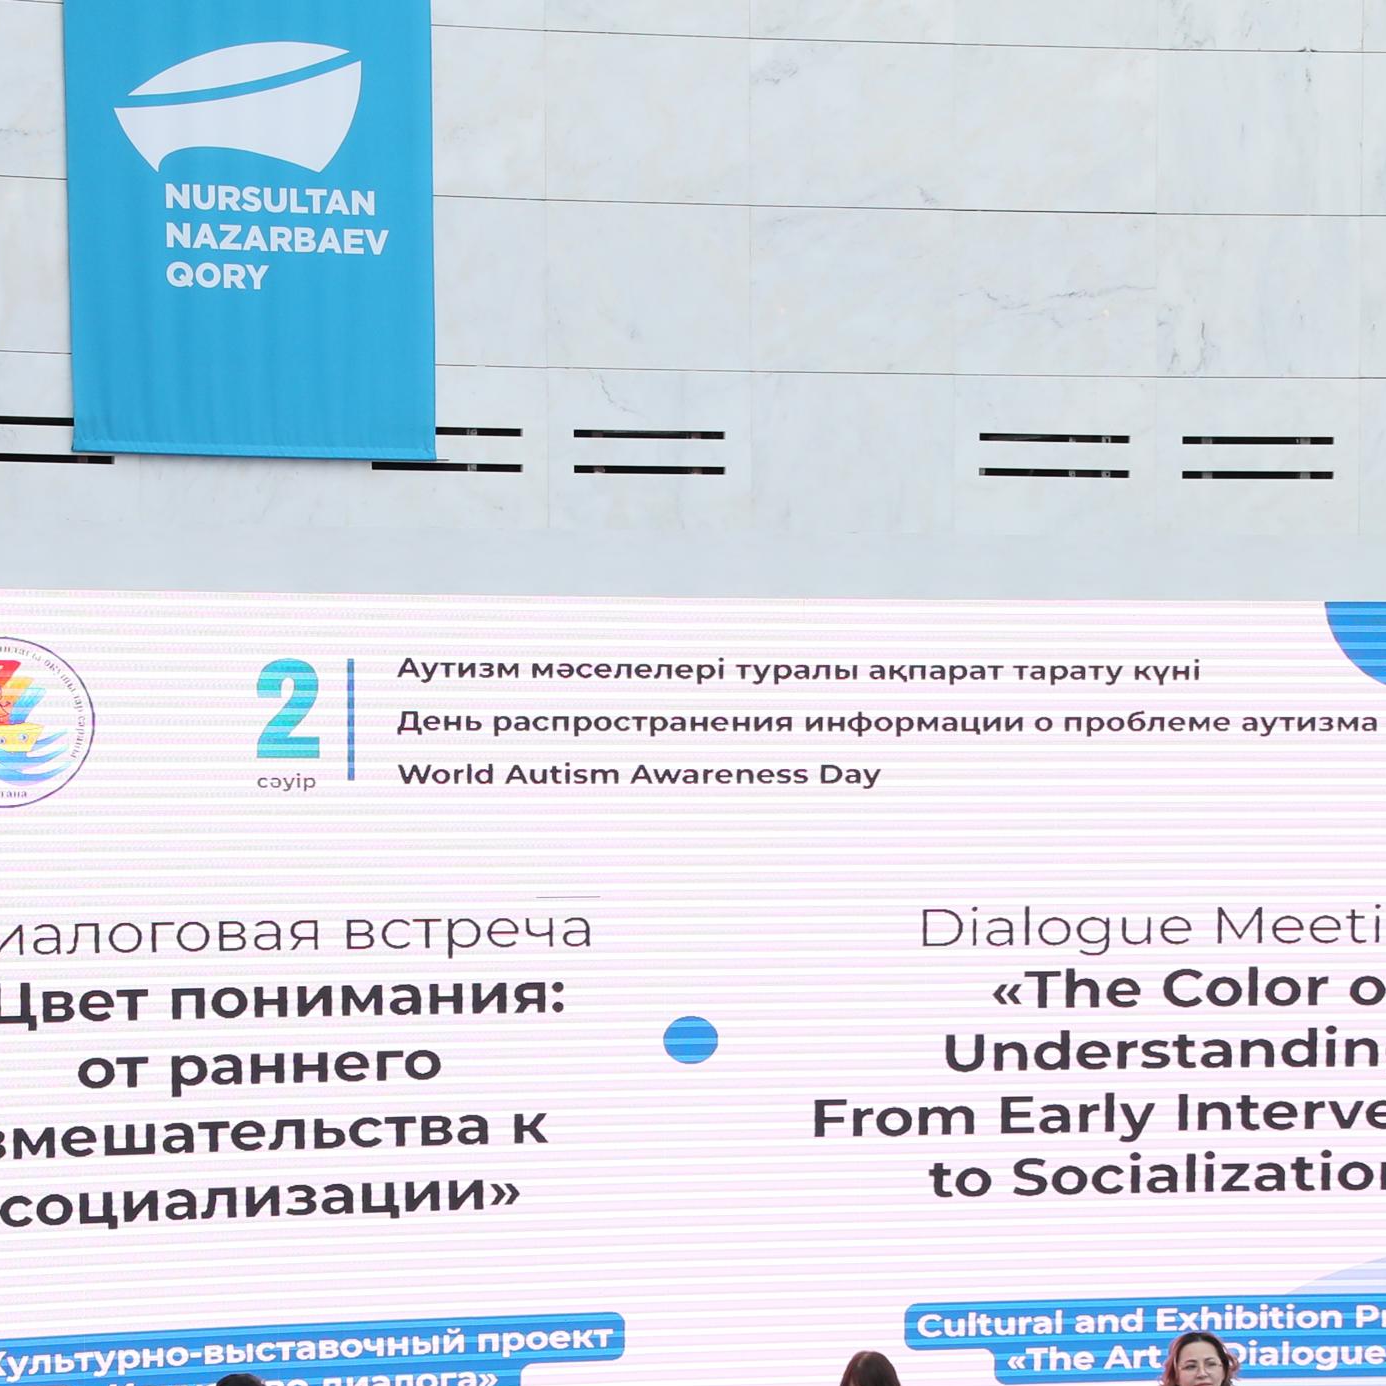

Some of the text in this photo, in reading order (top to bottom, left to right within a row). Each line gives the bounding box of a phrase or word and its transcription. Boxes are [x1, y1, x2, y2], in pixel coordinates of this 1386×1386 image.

[165, 183, 375, 216] NURSULTAN
[166, 223, 389, 256] NAZARBAEV
[166, 261, 270, 290] QORY
[398, 658, 1199, 685] Аутизм мәселелері туралы ақпарат тарату күні
[256, 657, 321, 760] 2
[397, 711, 1377, 737] День распространения информации о проблеме аутизма
[256, 773, 317, 793] сәуір
[398, 763, 880, 789] World Autism Awareness Day
[347, 918, 590, 958] встреча
[923, 906, 1191, 955] Dialogue
[172, 982, 563, 1019] понимания:
[993, 968, 1140, 1008] «The
[1163, 967, 1328, 1007] Color
[78, 1050, 441, 1097] от раннего
[514, 1113, 548, 1143] к
[815, 1099, 974, 1137] From
[1001, 1093, 1155, 1142] Early
[929, 1163, 991, 1197] to
[0, 1180, 519, 1229] социализации»
[917, 1309, 1063, 1339] Cultural
[1075, 1308, 1144, 1333] and
[1156, 1302, 1344, 1332] Exhibition
[477, 1326, 614, 1360] проект
[1007, 1346, 1096, 1372] «The
[1103, 1344, 1162, 1370] Art
